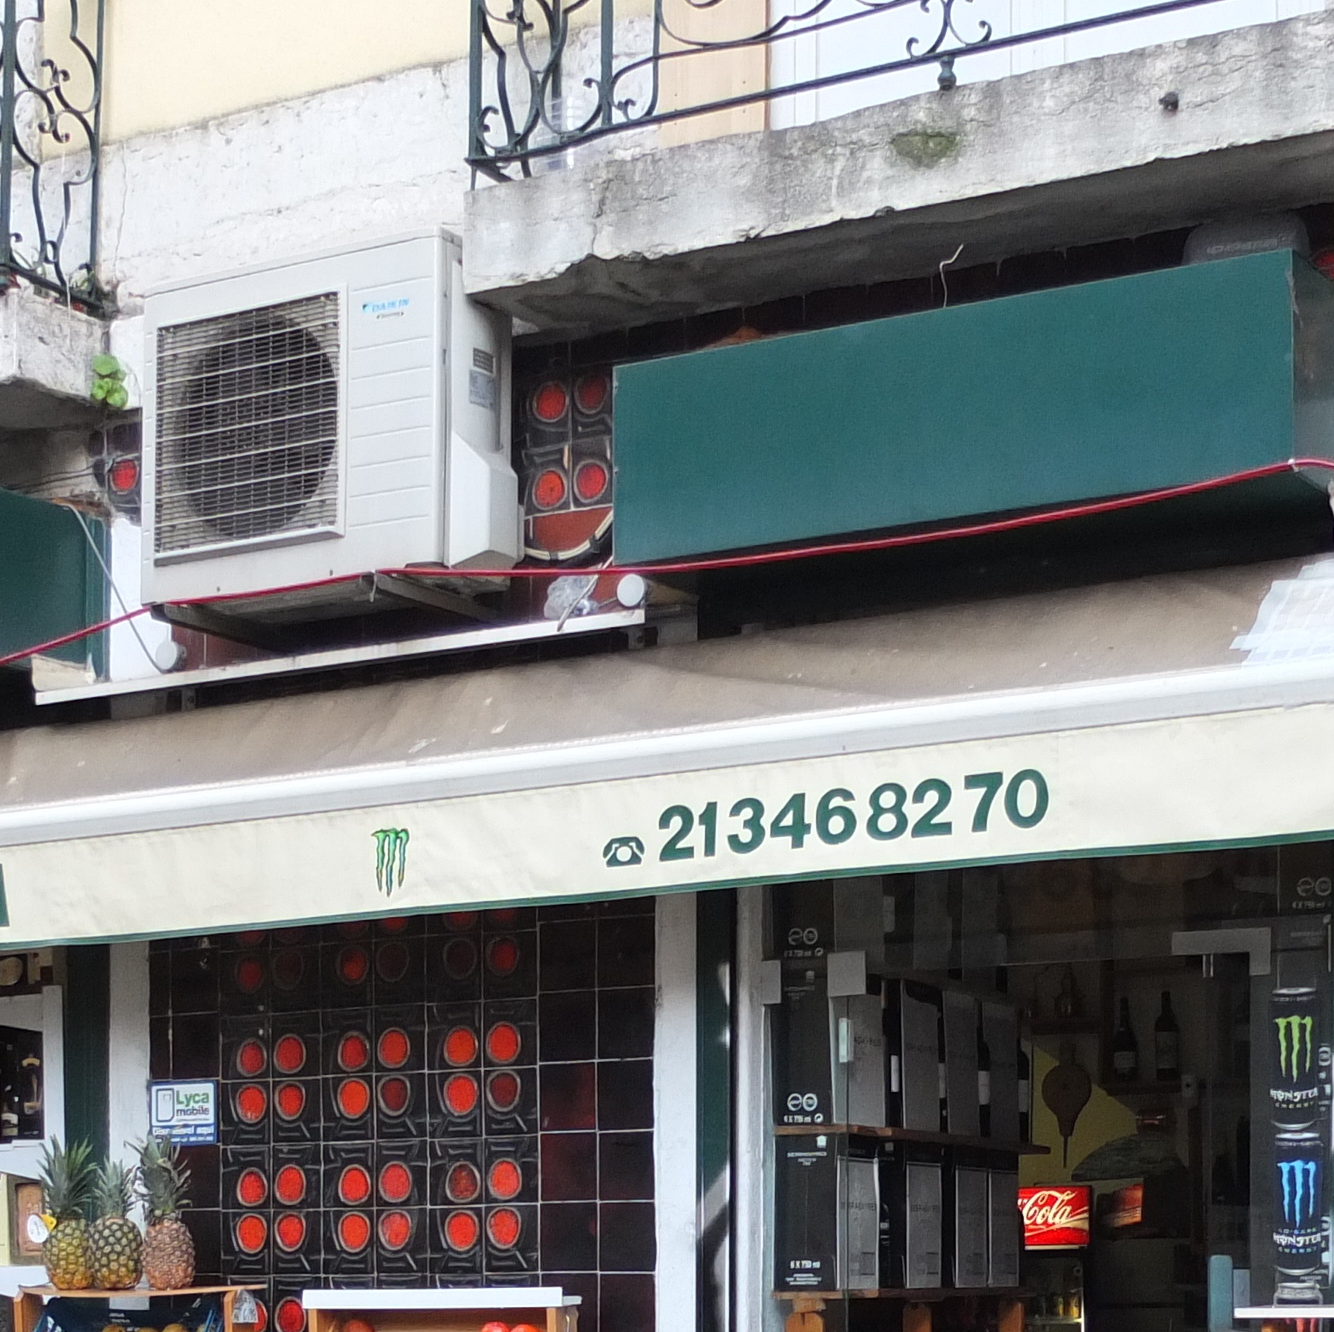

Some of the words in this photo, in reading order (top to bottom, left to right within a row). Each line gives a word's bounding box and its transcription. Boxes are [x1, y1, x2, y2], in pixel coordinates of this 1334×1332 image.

[658, 768, 1050, 862] 213468270
[176, 1090, 210, 1107] Lyca
[176, 1106, 210, 1117] mobile
[1022, 1191, 1077, 1225] Cola
